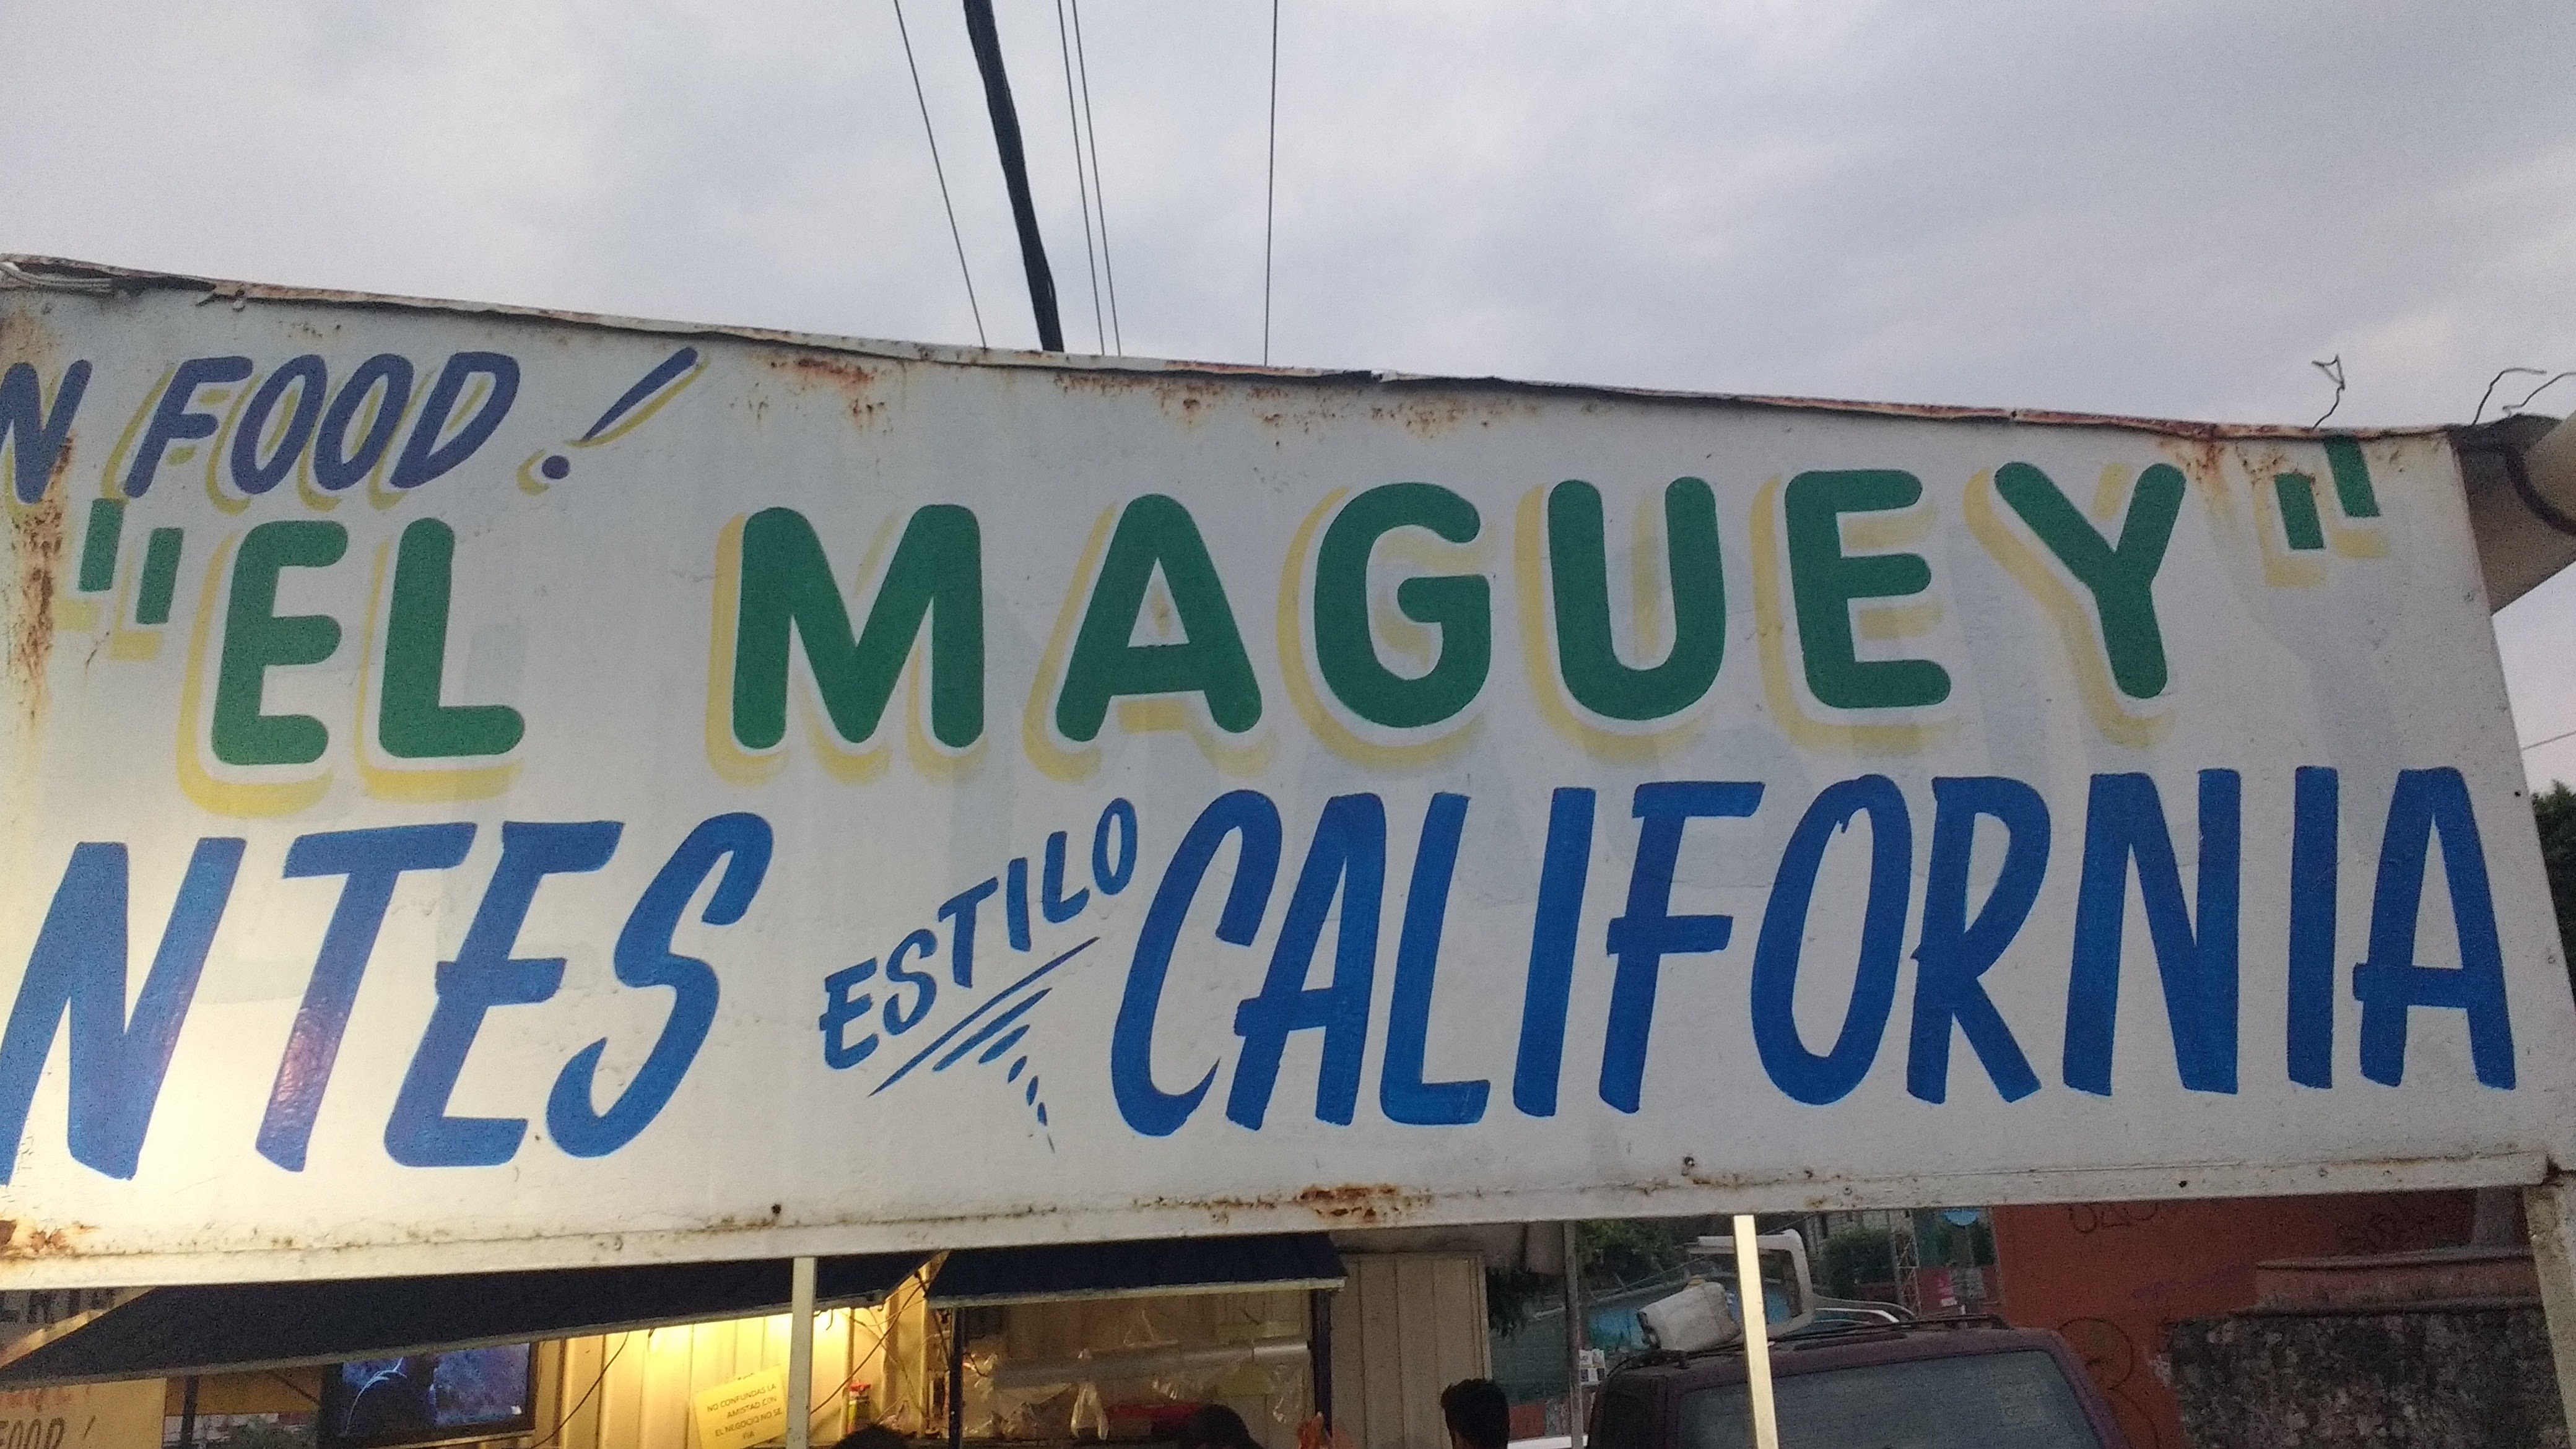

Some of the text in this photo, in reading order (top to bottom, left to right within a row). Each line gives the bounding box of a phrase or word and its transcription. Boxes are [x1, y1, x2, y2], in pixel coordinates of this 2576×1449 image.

[0, 766, 2516, 1186] NTES ESTILO CALIFORNIA
[707, 1383, 776, 1412] NO CONFUNDAS LA
[727, 1396, 777, 1419] AMISTAD CON
[725, 1416, 759, 1432] NEGOCIO
[760, 1411, 772, 1421] NO
[774, 1408, 782, 1416] SE
